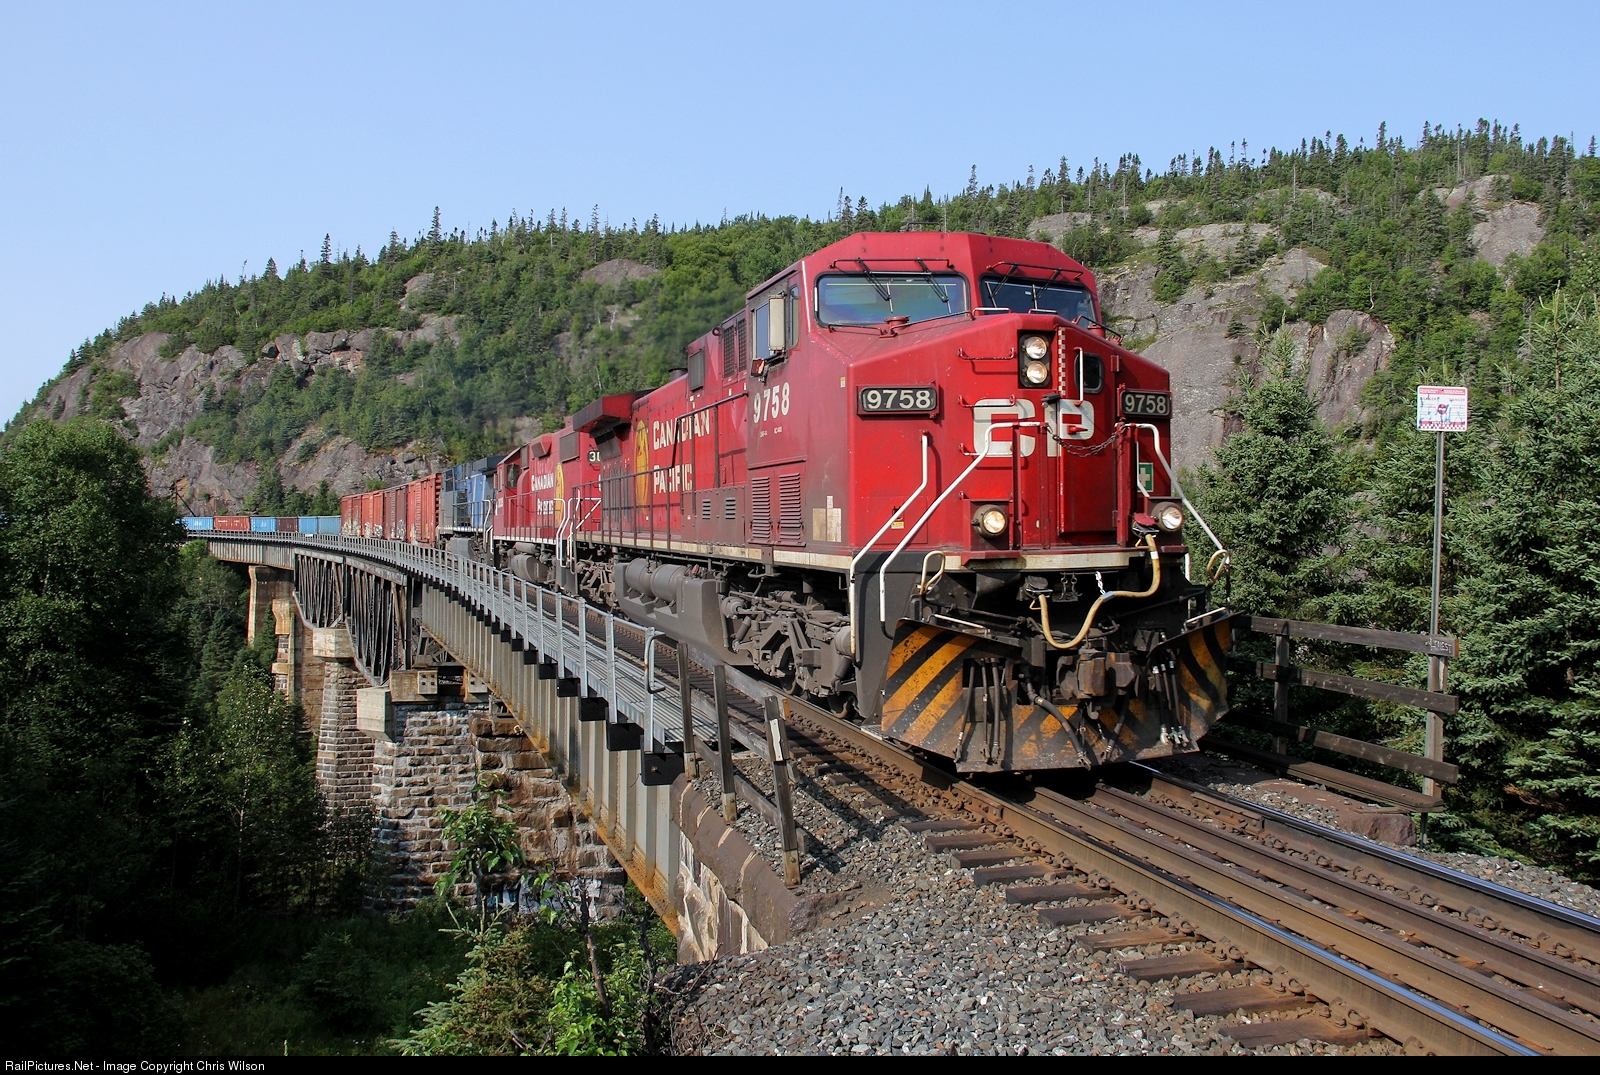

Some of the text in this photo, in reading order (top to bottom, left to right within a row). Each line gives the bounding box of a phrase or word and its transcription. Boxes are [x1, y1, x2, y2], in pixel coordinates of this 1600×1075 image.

[753, 381, 790, 424] 9758
[866, 389, 931, 409] 9758
[1124, 393, 1167, 414] 9758
[653, 409, 710, 450] CANADIAN
[973, 398, 1094, 457] CP
